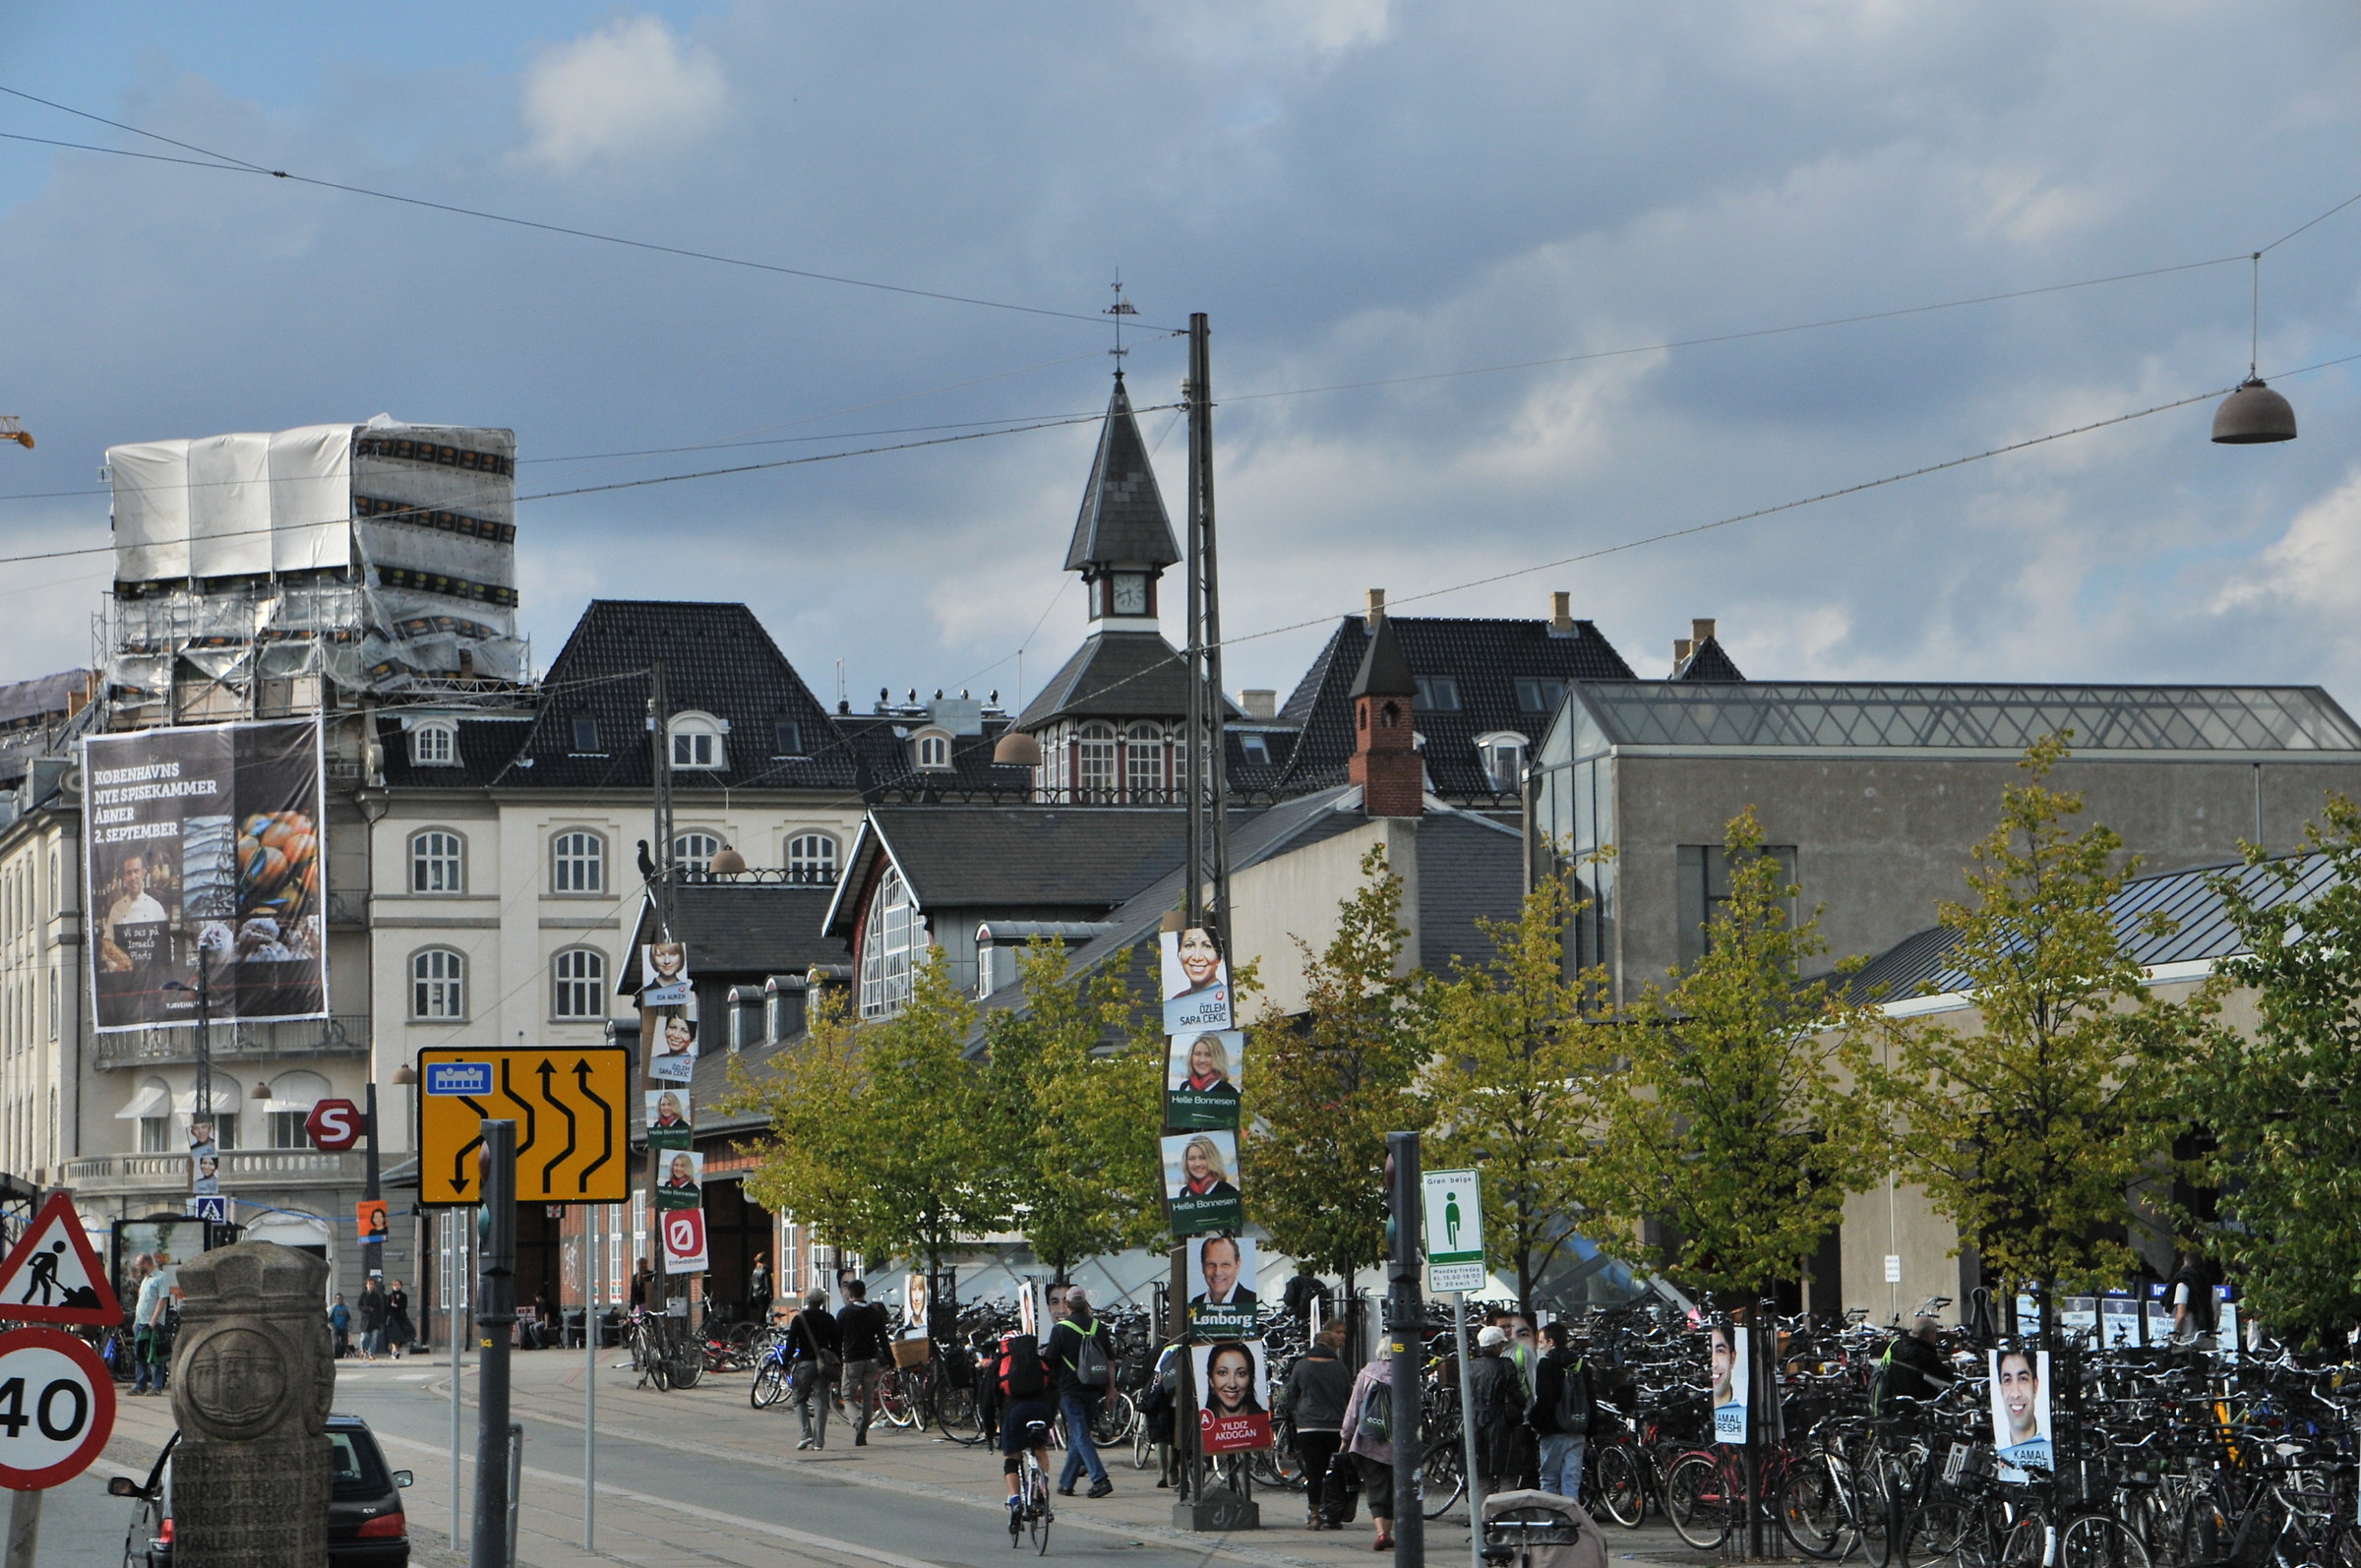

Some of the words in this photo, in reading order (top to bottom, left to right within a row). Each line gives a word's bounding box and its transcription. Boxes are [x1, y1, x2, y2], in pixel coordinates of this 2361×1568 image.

[93, 762, 180, 786] KØBENHAVNS
[94, 788, 119, 805] NYE
[120, 779, 217, 803] SPISEKAMMER
[94, 807, 134, 824] ÅBNER
[94, 829, 104, 844] 2.
[105, 821, 178, 843] SEPTEMBER
[1199, 1002, 1227, 1014] ÖZLEM
[1180, 1016, 1201, 1025] SARA
[1202, 1012, 1227, 1024] CEKIC
[1172, 1095, 1193, 1104] Helle
[1194, 1096, 1237, 1106] Bonnesen
[321, 1108, 351, 1142] S
[1172, 1202, 1195, 1211] Helle
[1196, 1197, 1238, 1209] Bonnesen
[668, 1257, 705, 1267] Enhedslisten
[1206, 1303, 1237, 1312] Mogens
[1192, 1311, 1253, 1328] Lønborg
[0, 1377, 89, 1442] 40
[1200, 1413, 1210, 1424] A
[1221, 1420, 1248, 1431] YILDIZ
[1215, 1429, 1257, 1441] AKDOGAN
[2014, 1449, 2048, 1461] KAMAL
